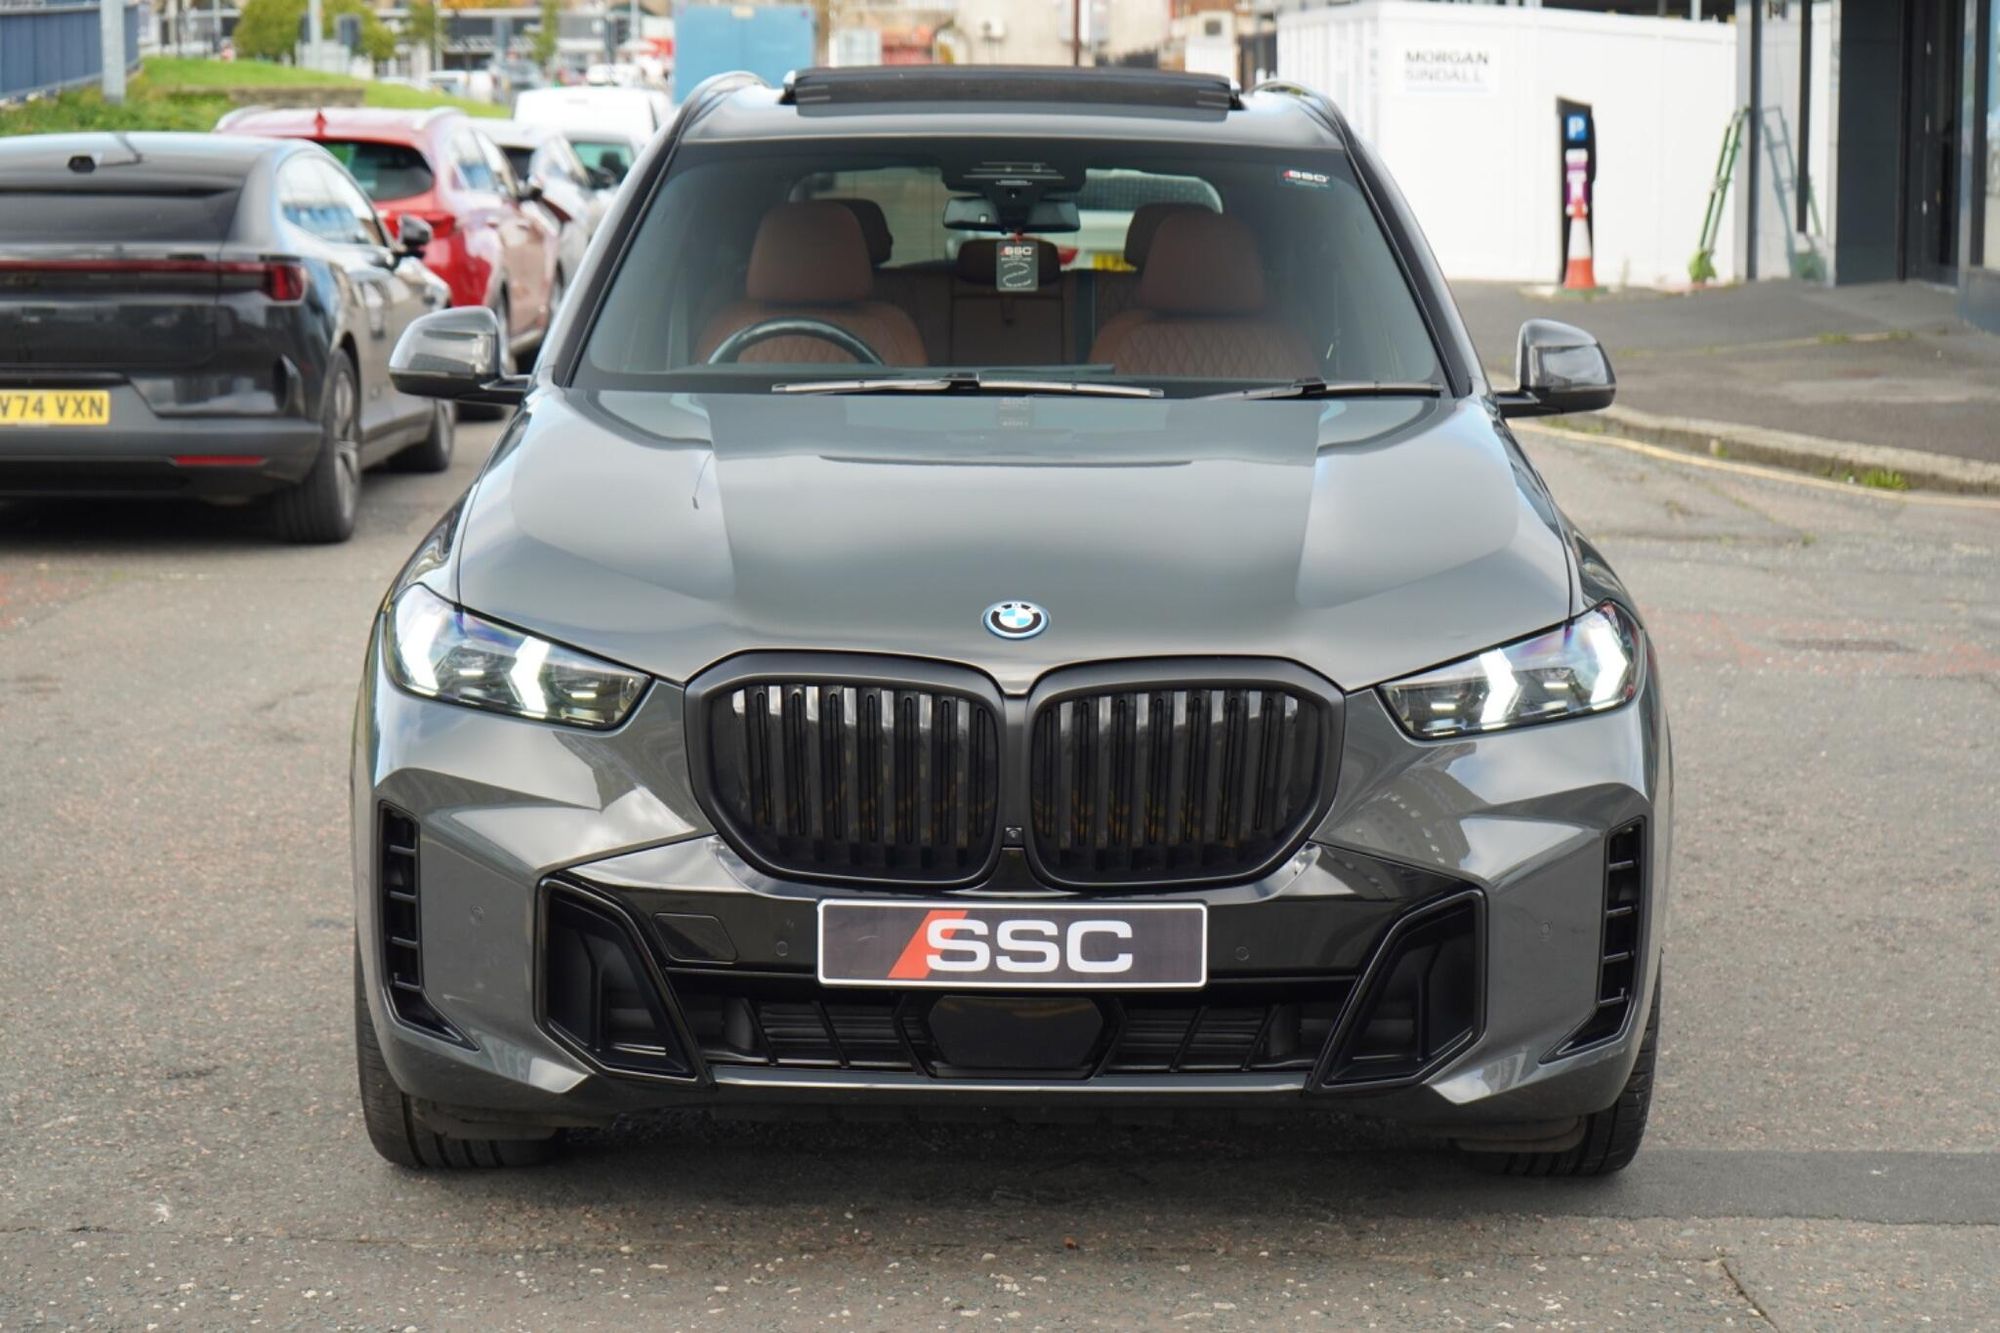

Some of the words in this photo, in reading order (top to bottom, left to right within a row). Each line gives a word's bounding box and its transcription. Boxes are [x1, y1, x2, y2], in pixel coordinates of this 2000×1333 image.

[1405, 50, 1489, 64] MORGAN
[1405, 69, 1485, 83] SINDALL
[1568, 116, 1586, 140] P
[56, 395, 104, 417] VXN
[926, 918, 1134, 973] SSC
